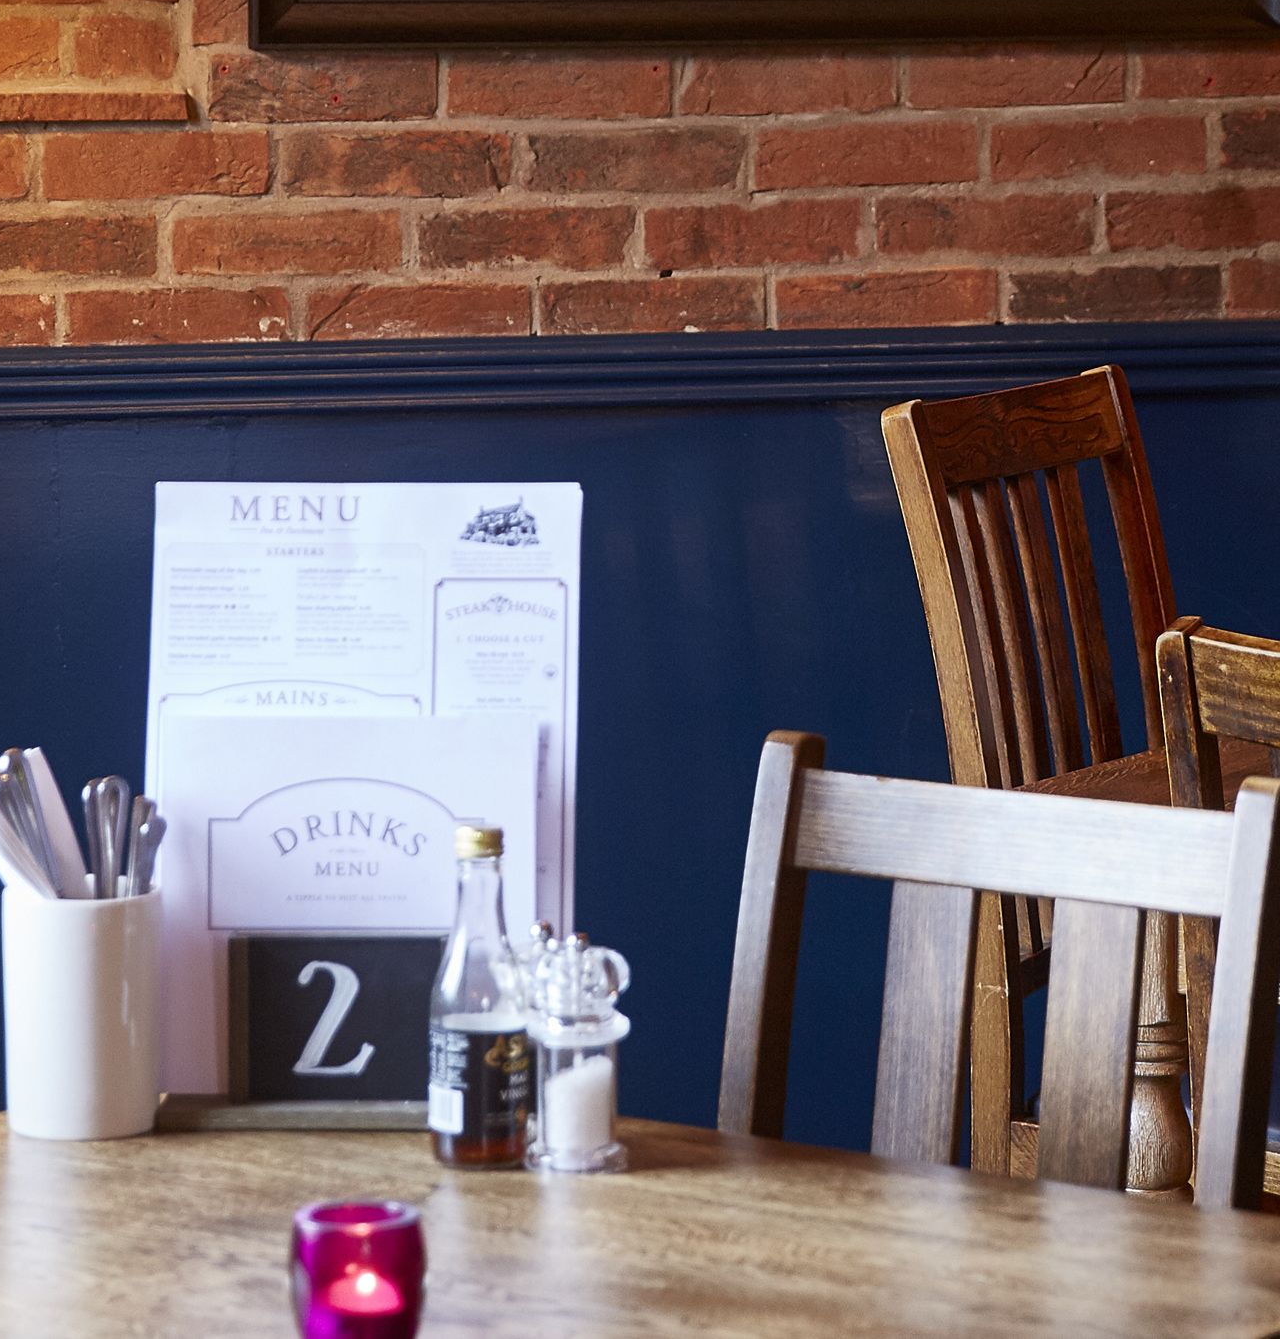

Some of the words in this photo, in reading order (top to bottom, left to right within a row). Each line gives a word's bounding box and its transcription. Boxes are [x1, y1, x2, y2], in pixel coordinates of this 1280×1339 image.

[230, 495, 361, 522] MENU
[266, 547, 325, 556] STARTERS
[507, 601, 558, 620] HOUSE
[256, 691, 328, 706] MAINS
[270, 810, 427, 857] DRINKS
[314, 862, 380, 876] MENU
[292, 961, 376, 1076] 2
